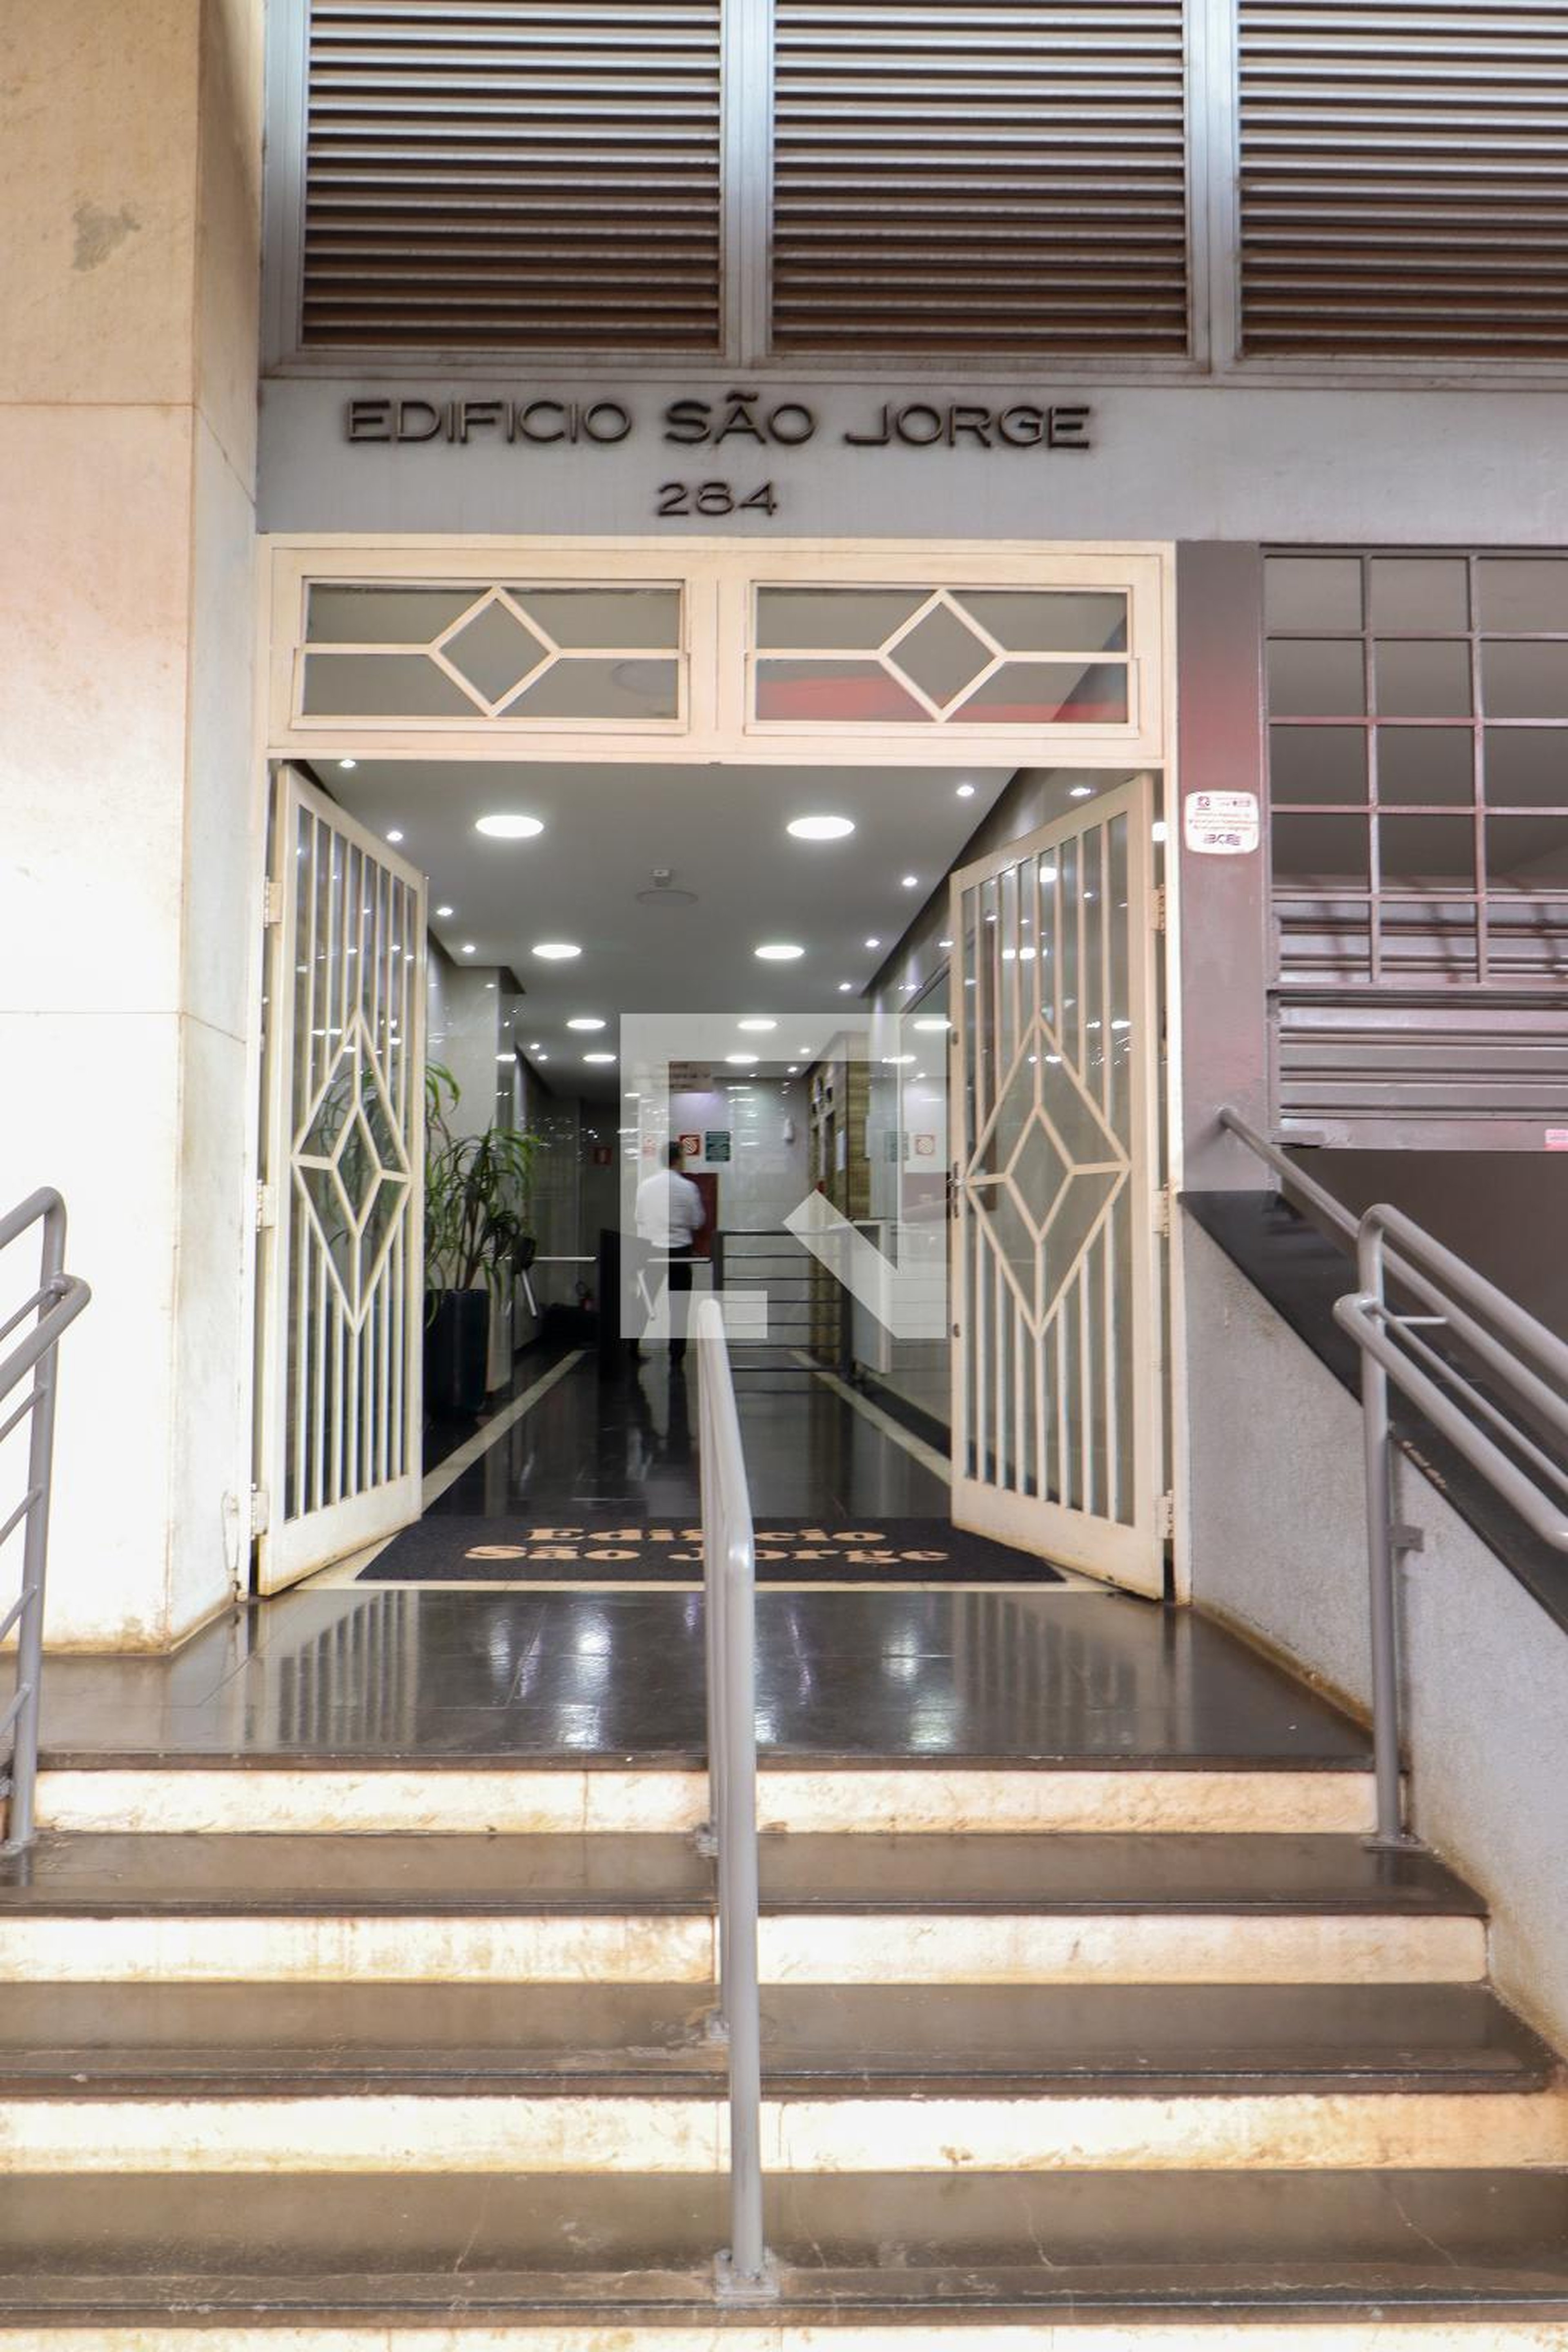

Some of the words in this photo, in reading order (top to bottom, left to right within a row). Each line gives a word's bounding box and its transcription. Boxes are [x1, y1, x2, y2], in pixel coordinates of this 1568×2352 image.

[347, 400, 631, 444] EDIFICIO
[665, 391, 815, 445] SÃO
[844, 403, 1090, 449] JORGE
[658, 480, 777, 516] 284
[526, 1528, 886, 1541] Edifcio
